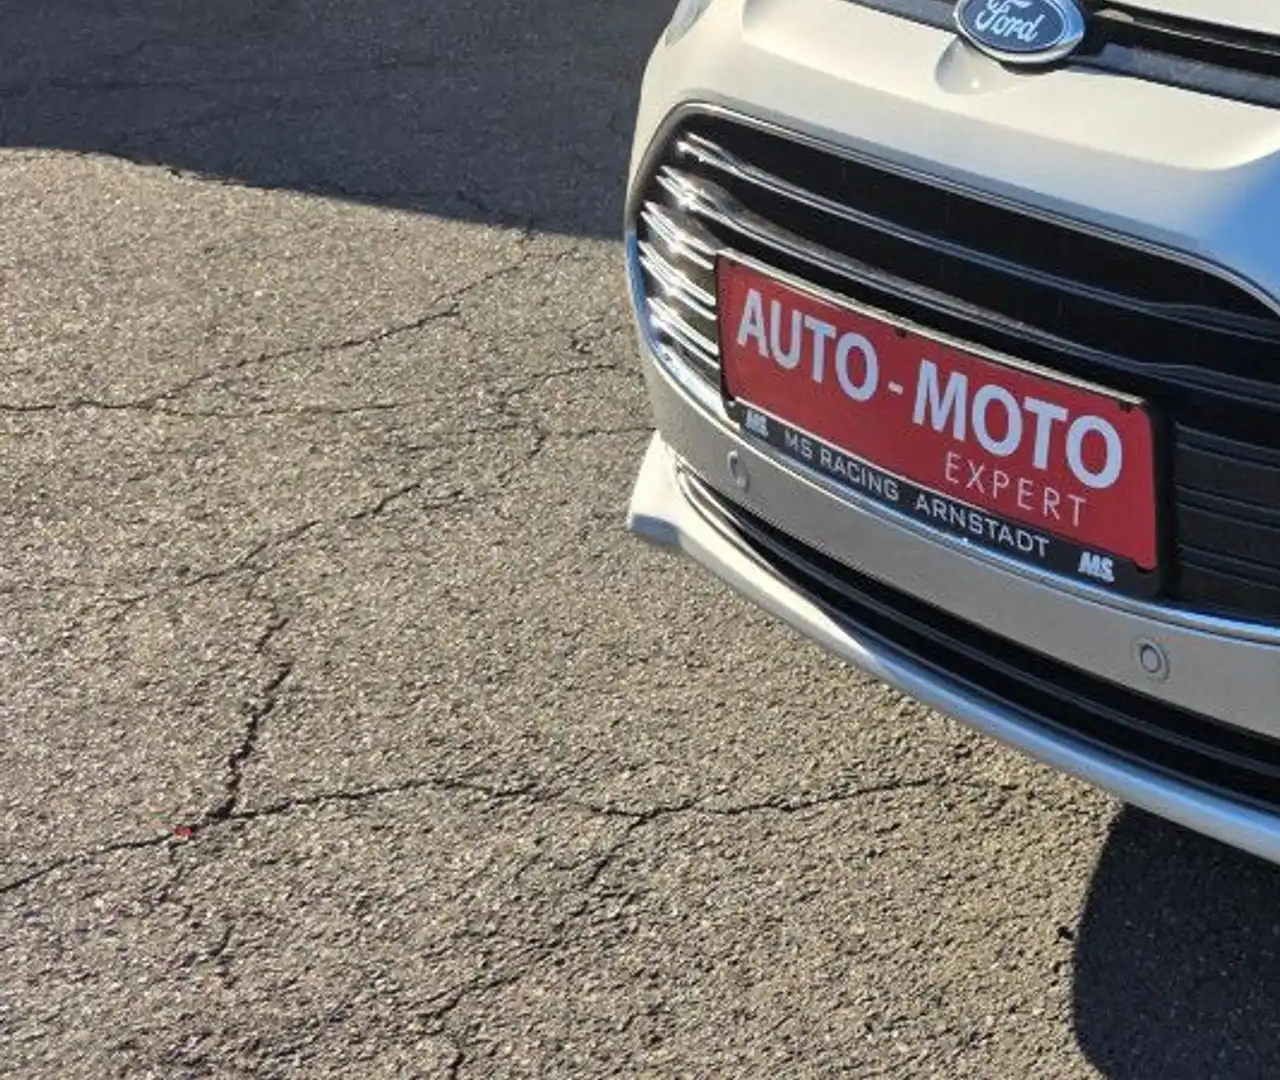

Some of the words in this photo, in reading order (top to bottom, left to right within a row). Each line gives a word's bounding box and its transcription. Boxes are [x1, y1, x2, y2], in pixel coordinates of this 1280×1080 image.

[784, 428, 814, 461] MS
[820, 446, 899, 501] RACING
[915, 493, 1050, 558] ARNSTADT
[944, 450, 1087, 528] EXPERT
